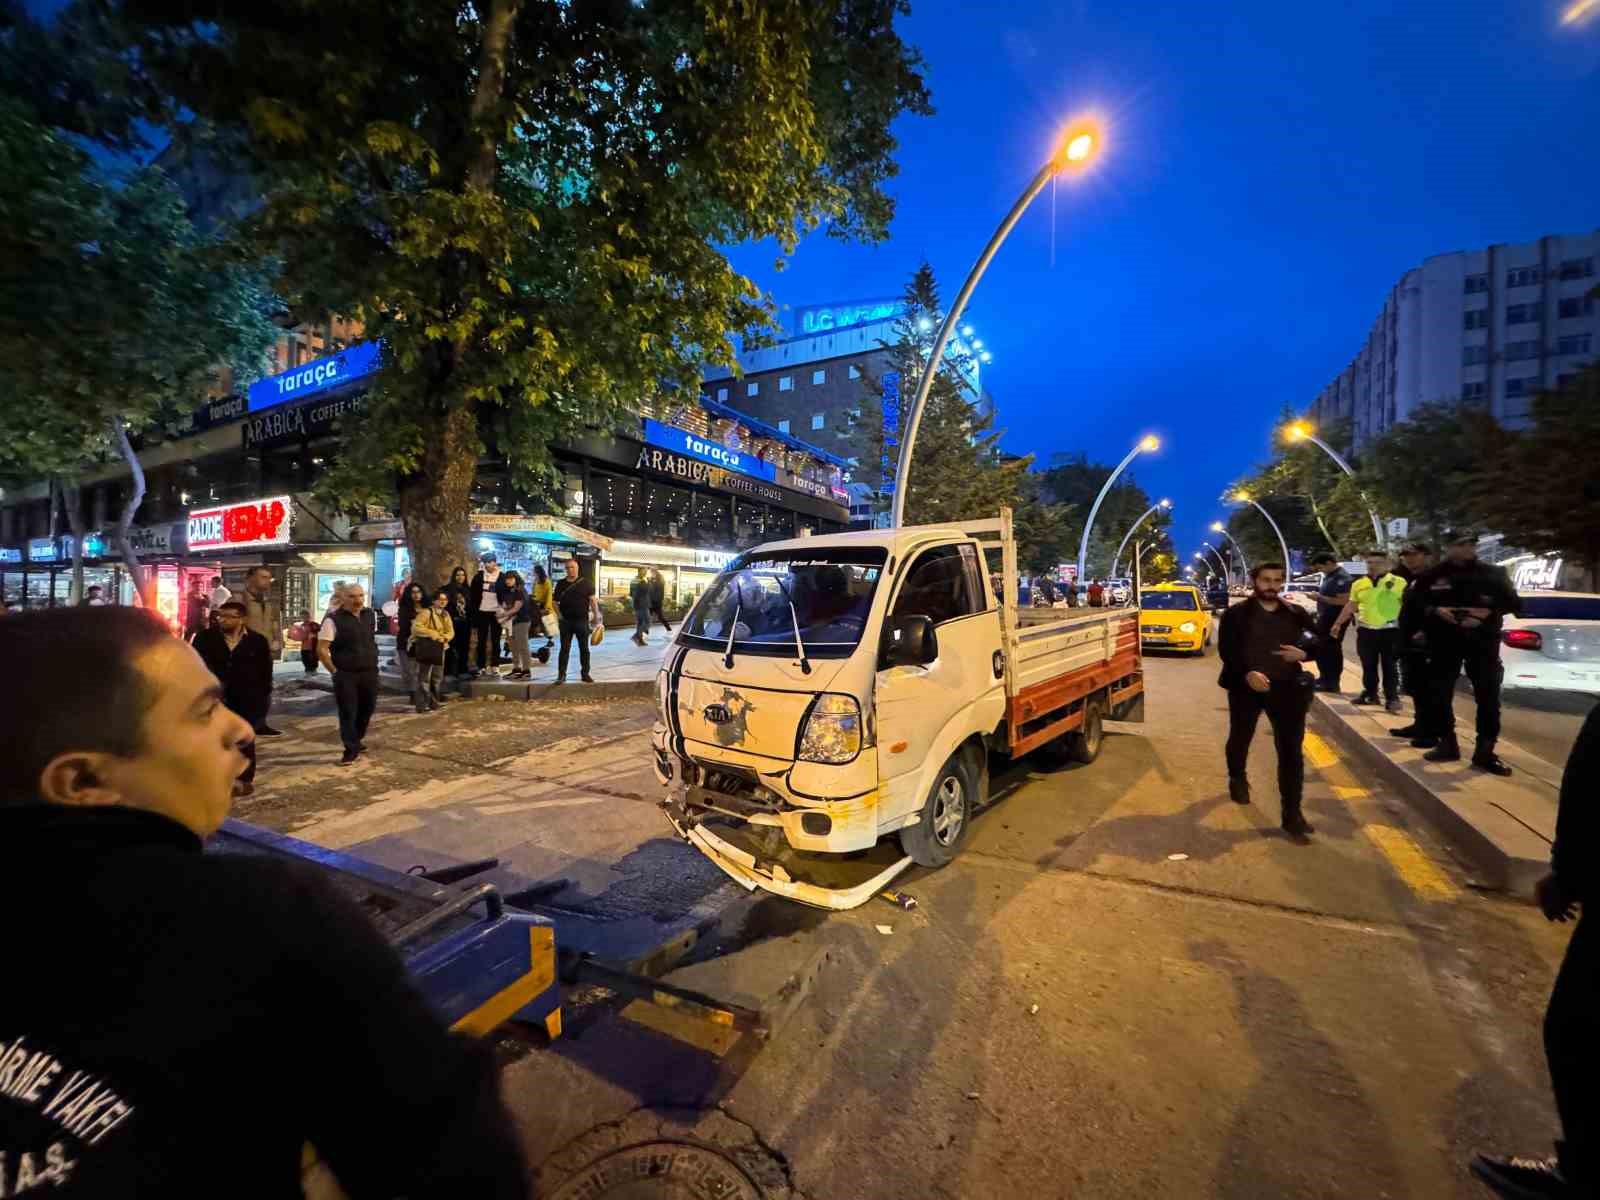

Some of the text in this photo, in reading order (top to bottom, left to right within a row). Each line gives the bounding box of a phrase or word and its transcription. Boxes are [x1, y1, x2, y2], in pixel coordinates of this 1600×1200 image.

[277, 360, 337, 394] taraça
[246, 408, 306, 448] ARABICA
[685, 436, 740, 466] taraça
[636, 447, 711, 481] ARABICA
[725, 476, 753, 494] COFFEE
[188, 515, 221, 541] CADDE
[42, 1069, 136, 1144] VAKFI
